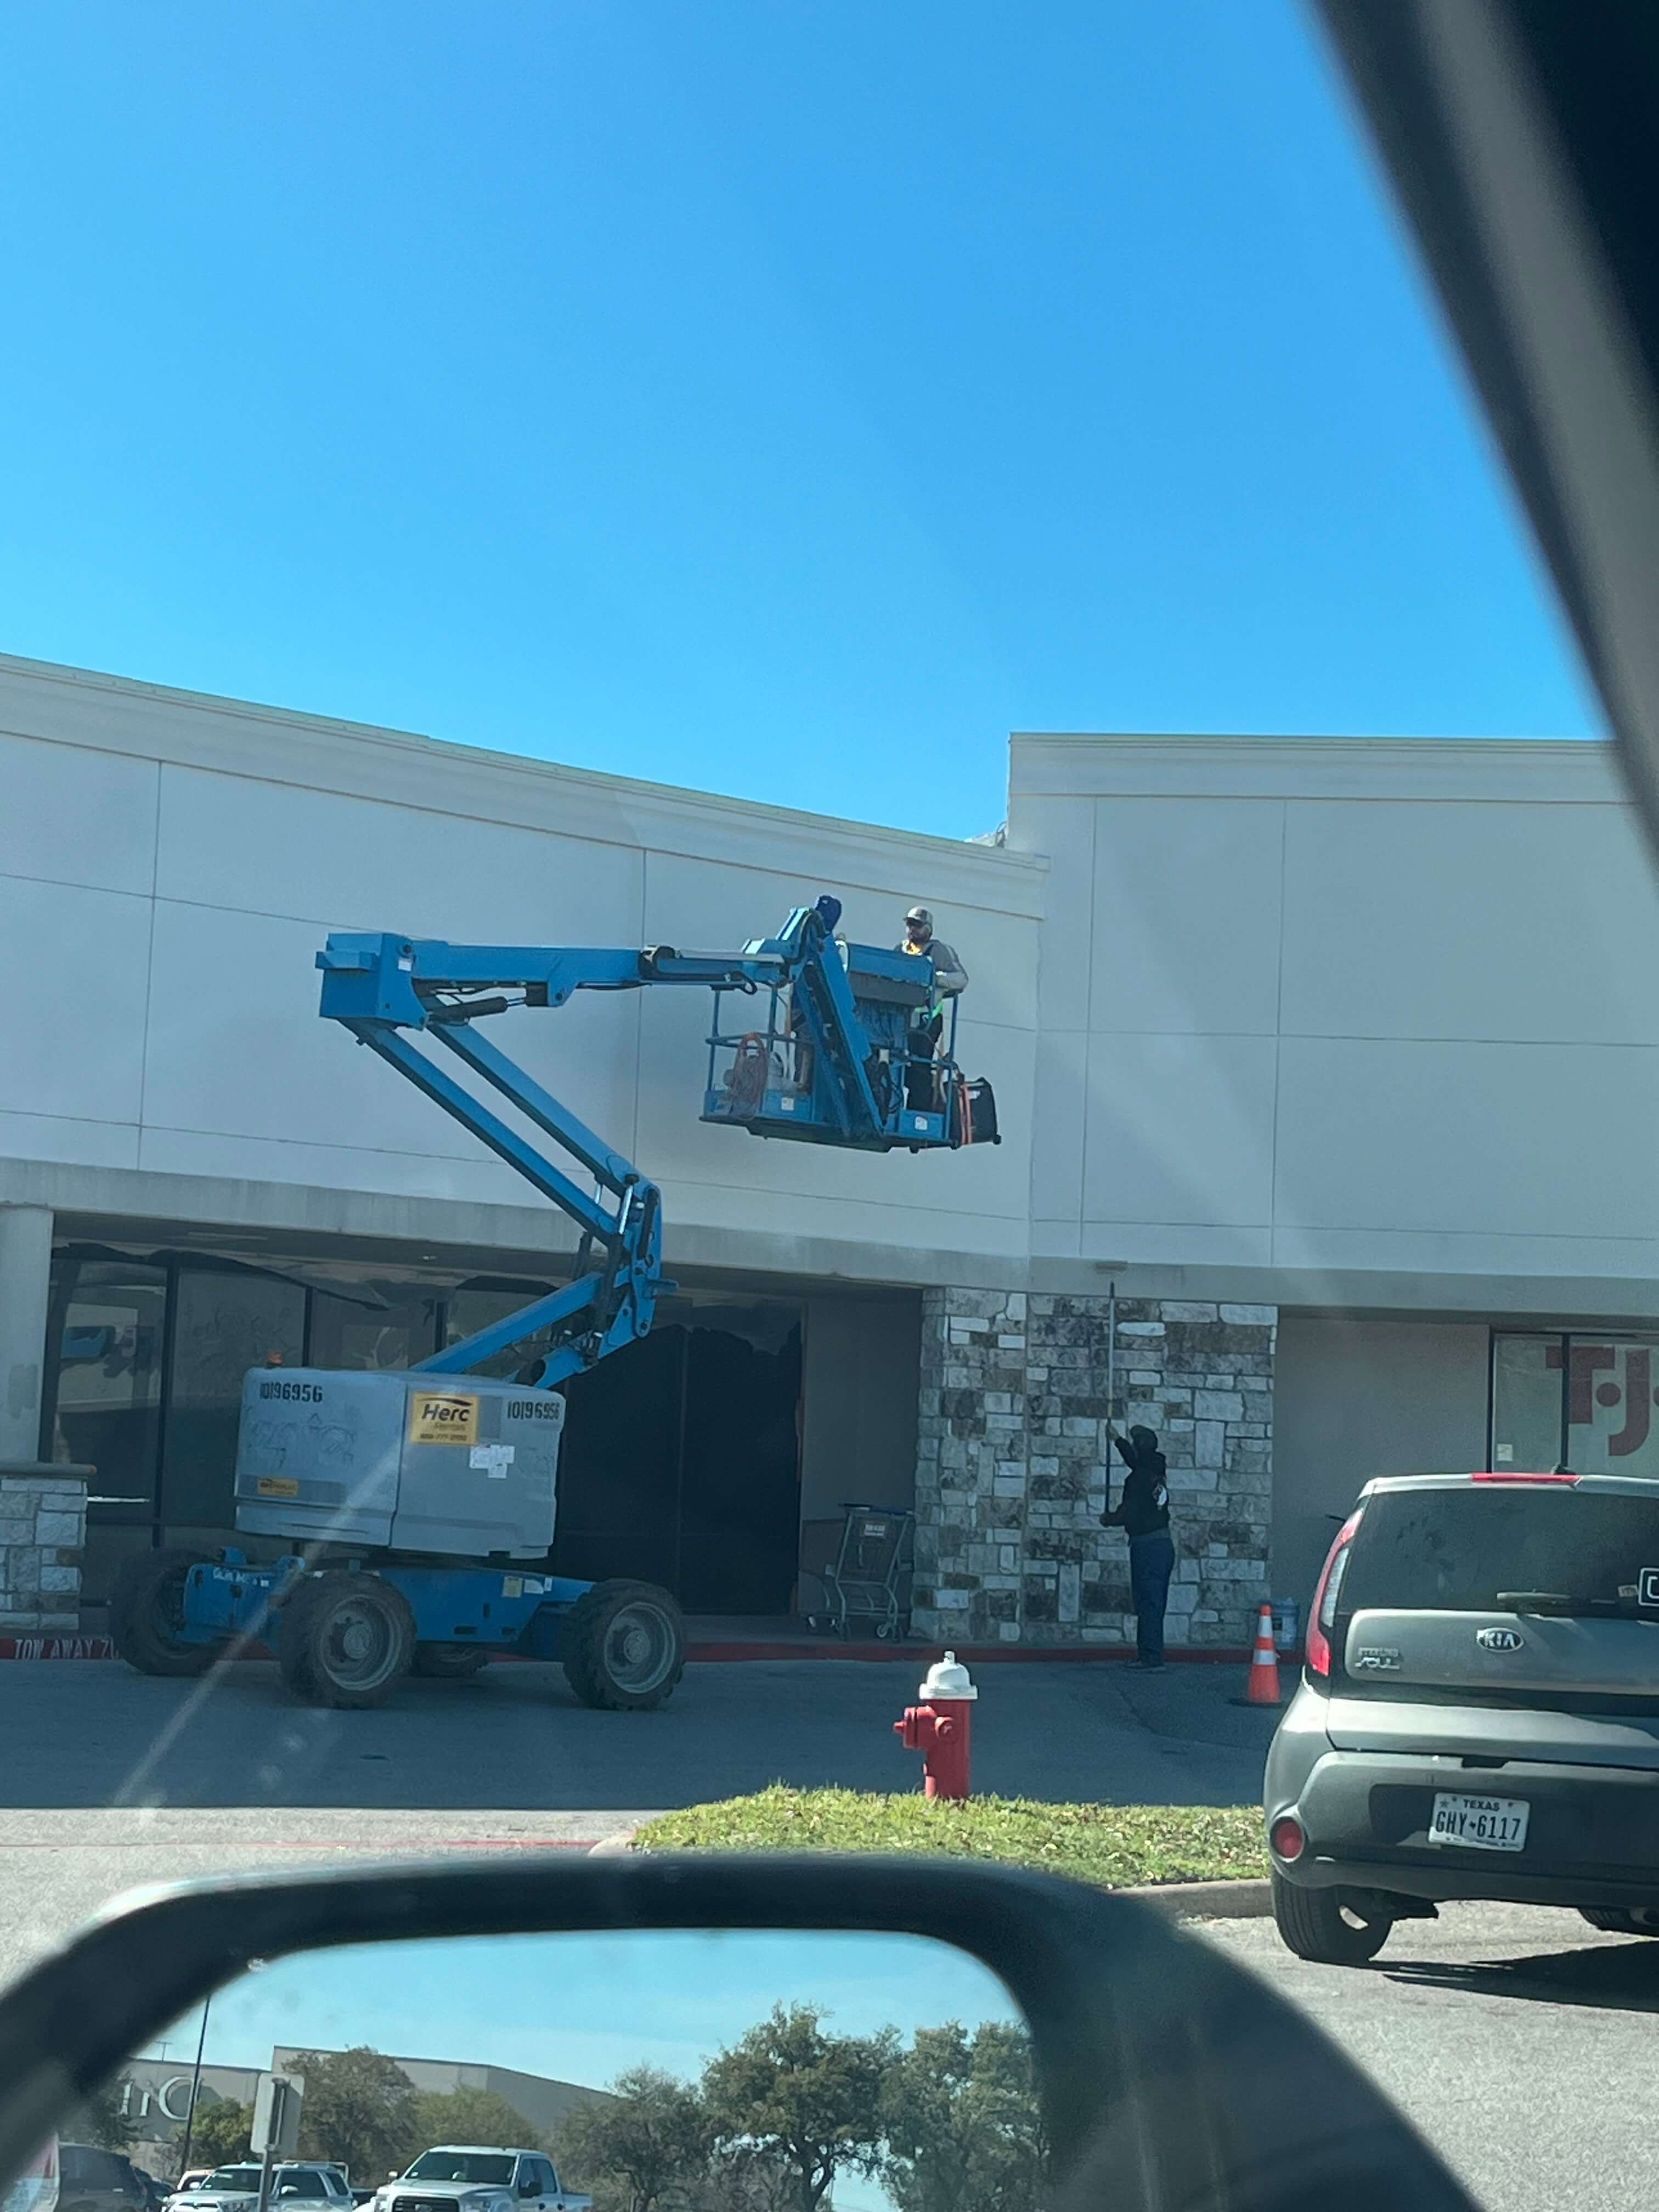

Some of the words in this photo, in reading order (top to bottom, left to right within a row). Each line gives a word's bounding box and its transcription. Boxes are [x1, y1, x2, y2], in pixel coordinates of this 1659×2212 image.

[421, 1404, 470, 1421] Herc
[1483, 1632, 1515, 1648] KIA
[14, 1639, 44, 1659] TOW
[50, 1639, 93, 1659] AWAY
[1355, 1656, 1400, 1670] SOUL
[1463, 1799, 1500, 1812] TEXAS
[1477, 1815, 1521, 1841] 6117
